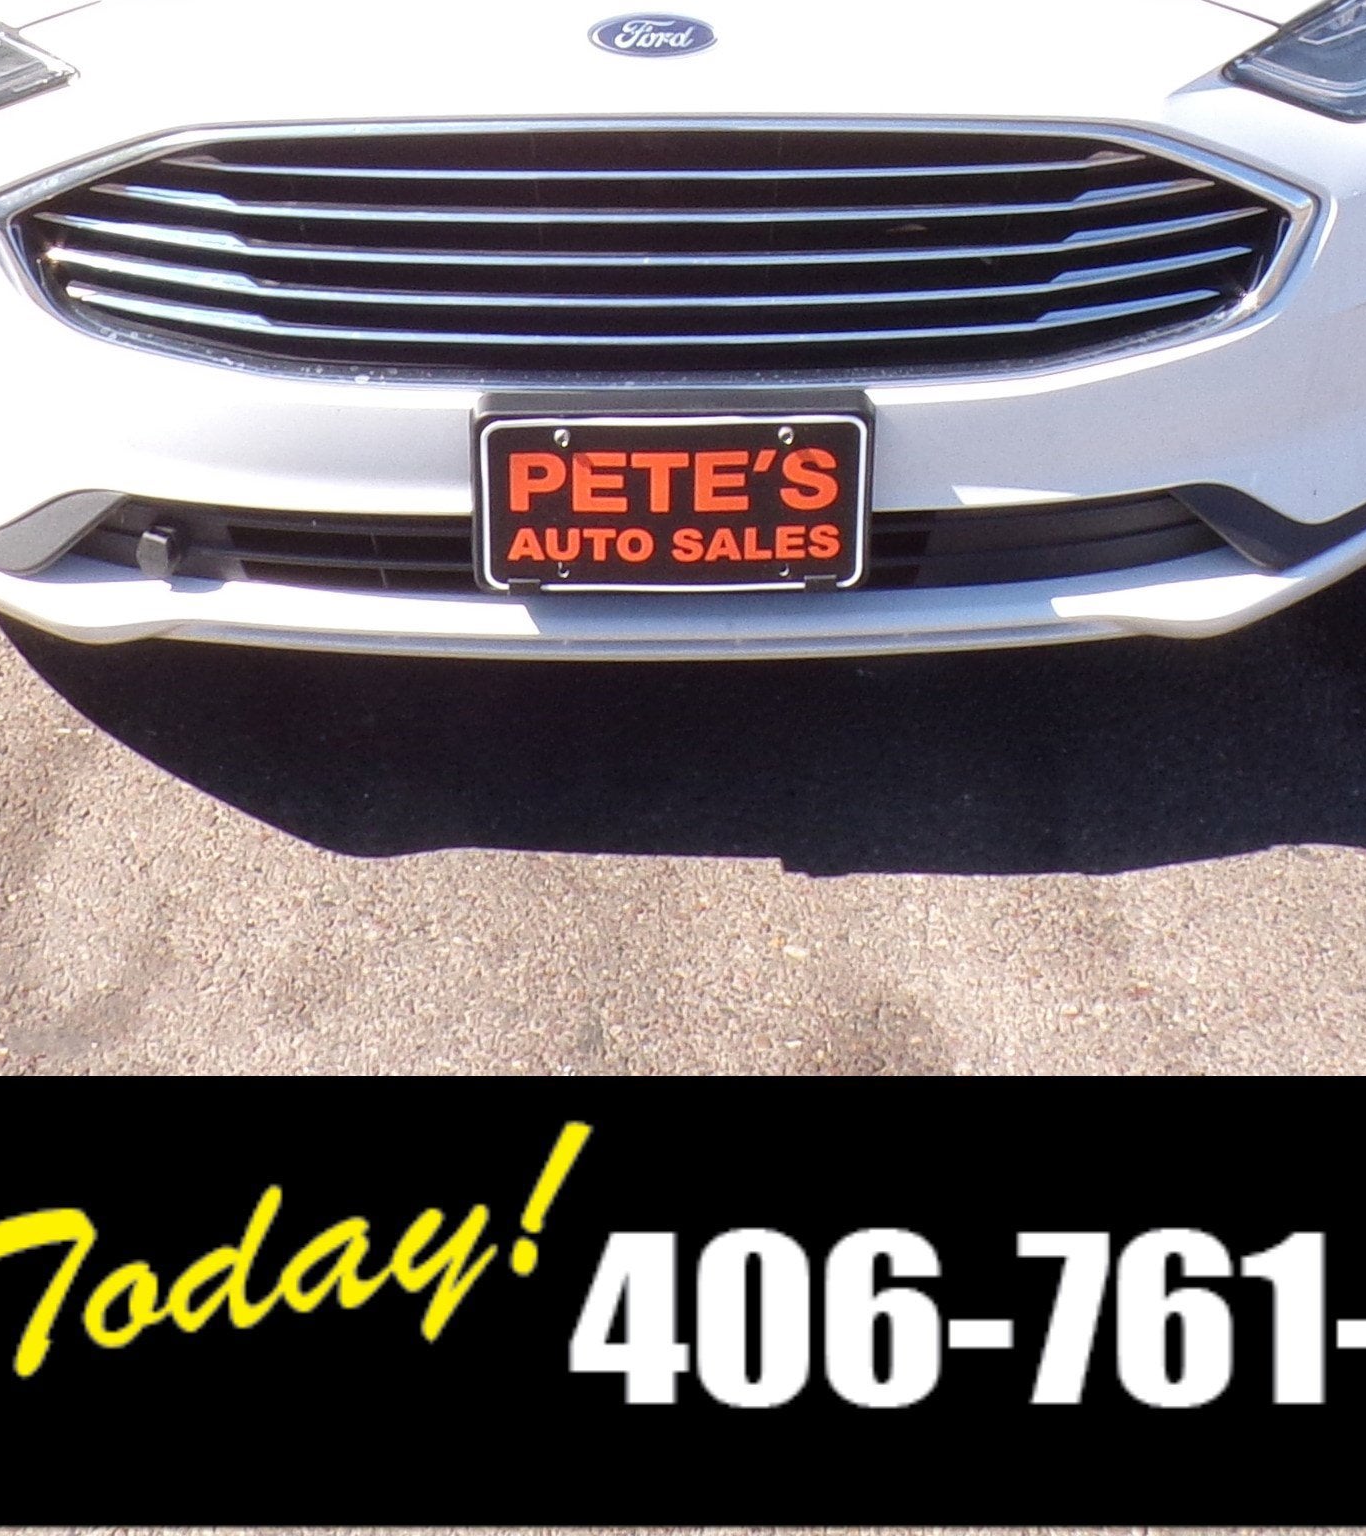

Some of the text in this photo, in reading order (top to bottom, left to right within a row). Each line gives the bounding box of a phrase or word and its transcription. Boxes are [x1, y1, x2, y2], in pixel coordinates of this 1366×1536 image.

[614, 19, 695, 50] Ford
[508, 449, 840, 514] PETE'S
[508, 524, 840, 562] AUTO SALES
